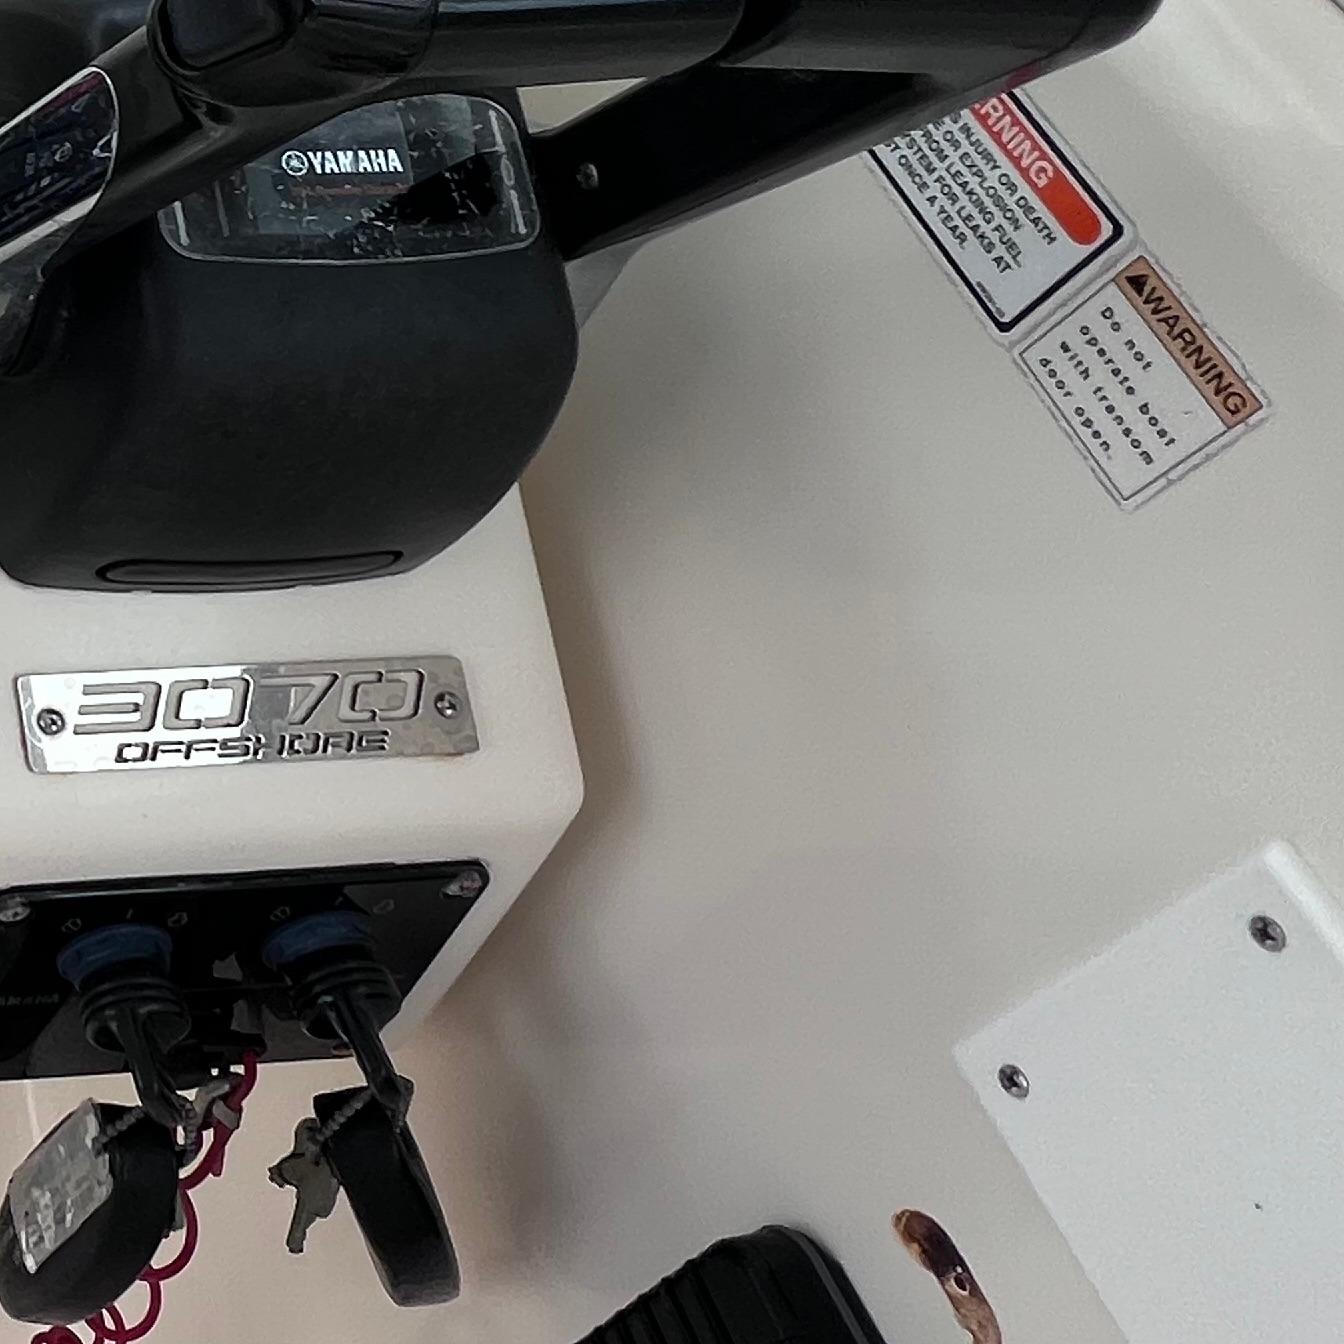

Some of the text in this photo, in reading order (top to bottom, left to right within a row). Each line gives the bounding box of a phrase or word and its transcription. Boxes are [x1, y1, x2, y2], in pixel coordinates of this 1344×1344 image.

[307, 148, 404, 174] YAMAHA
[898, 154, 930, 194] ONCE
[925, 194, 939, 208] A
[921, 129, 951, 164] ROM
[945, 162, 996, 225] LEAKING
[942, 129, 963, 153] OR
[959, 151, 1024, 233] EXPLOSION
[959, 122, 1057, 246] INJURY OR DEATH
[974, 97, 1054, 189] RNING
[933, 175, 960, 206] FOR
[957, 206, 996, 255] LEAKS
[992, 254, 1014, 274] AT
[1038, 356, 1074, 399] door
[1078, 324, 1177, 448] operate boat
[1099, 306, 1154, 374] Do not
[1141, 285, 1249, 419] WARNING
[1059, 340, 1155, 467] with transom
[73, 668, 426, 736] 3070
[114, 729, 392, 764] OFFSHORE
